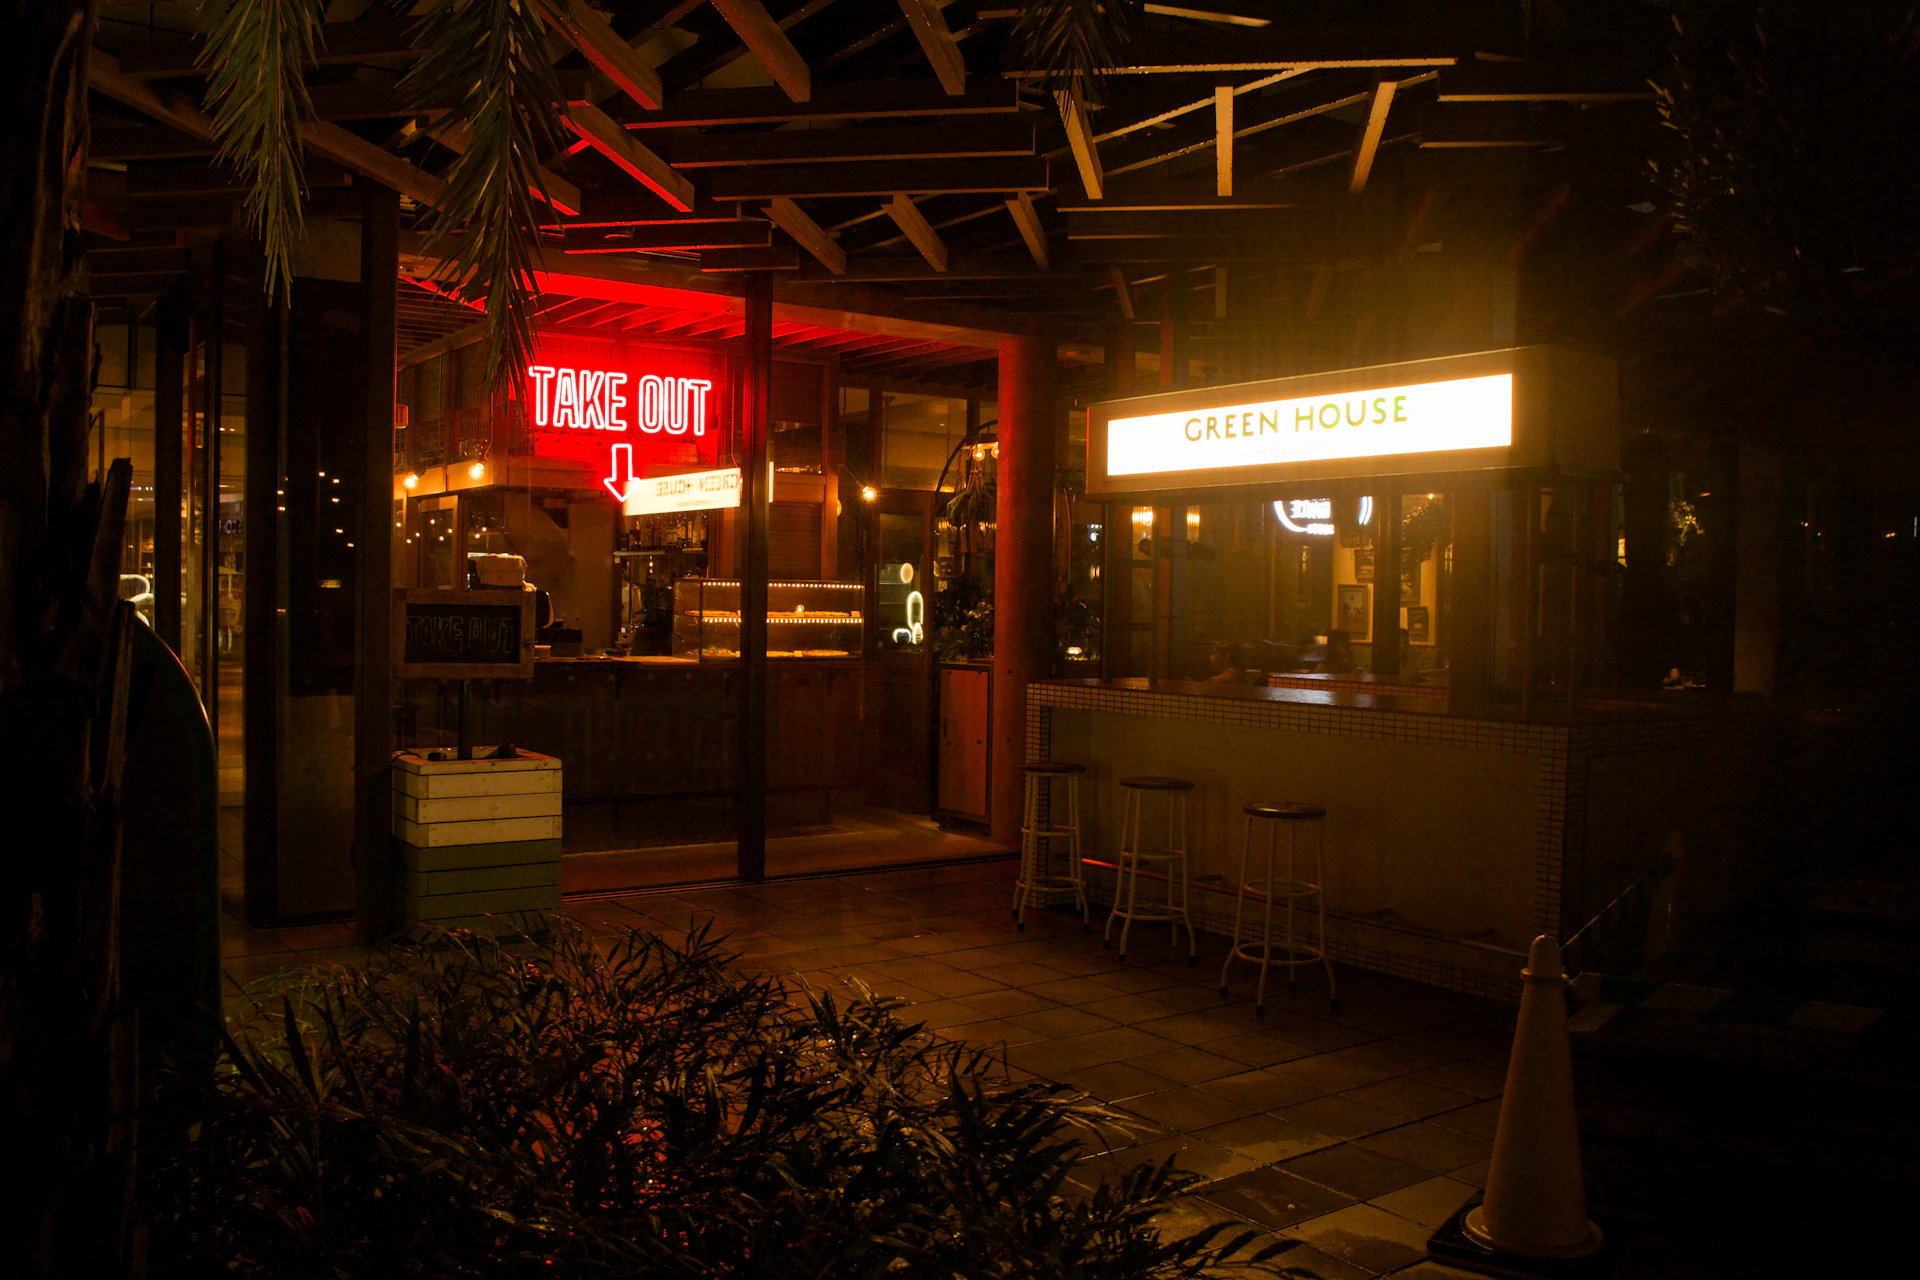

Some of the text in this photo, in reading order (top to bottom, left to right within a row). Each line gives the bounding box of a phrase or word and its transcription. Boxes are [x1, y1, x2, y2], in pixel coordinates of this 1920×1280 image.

[528, 366, 712, 436] TAKE OUT
[1184, 395, 1408, 442] GREEN HOUSE
[407, 615, 518, 654] TAKE OUT
